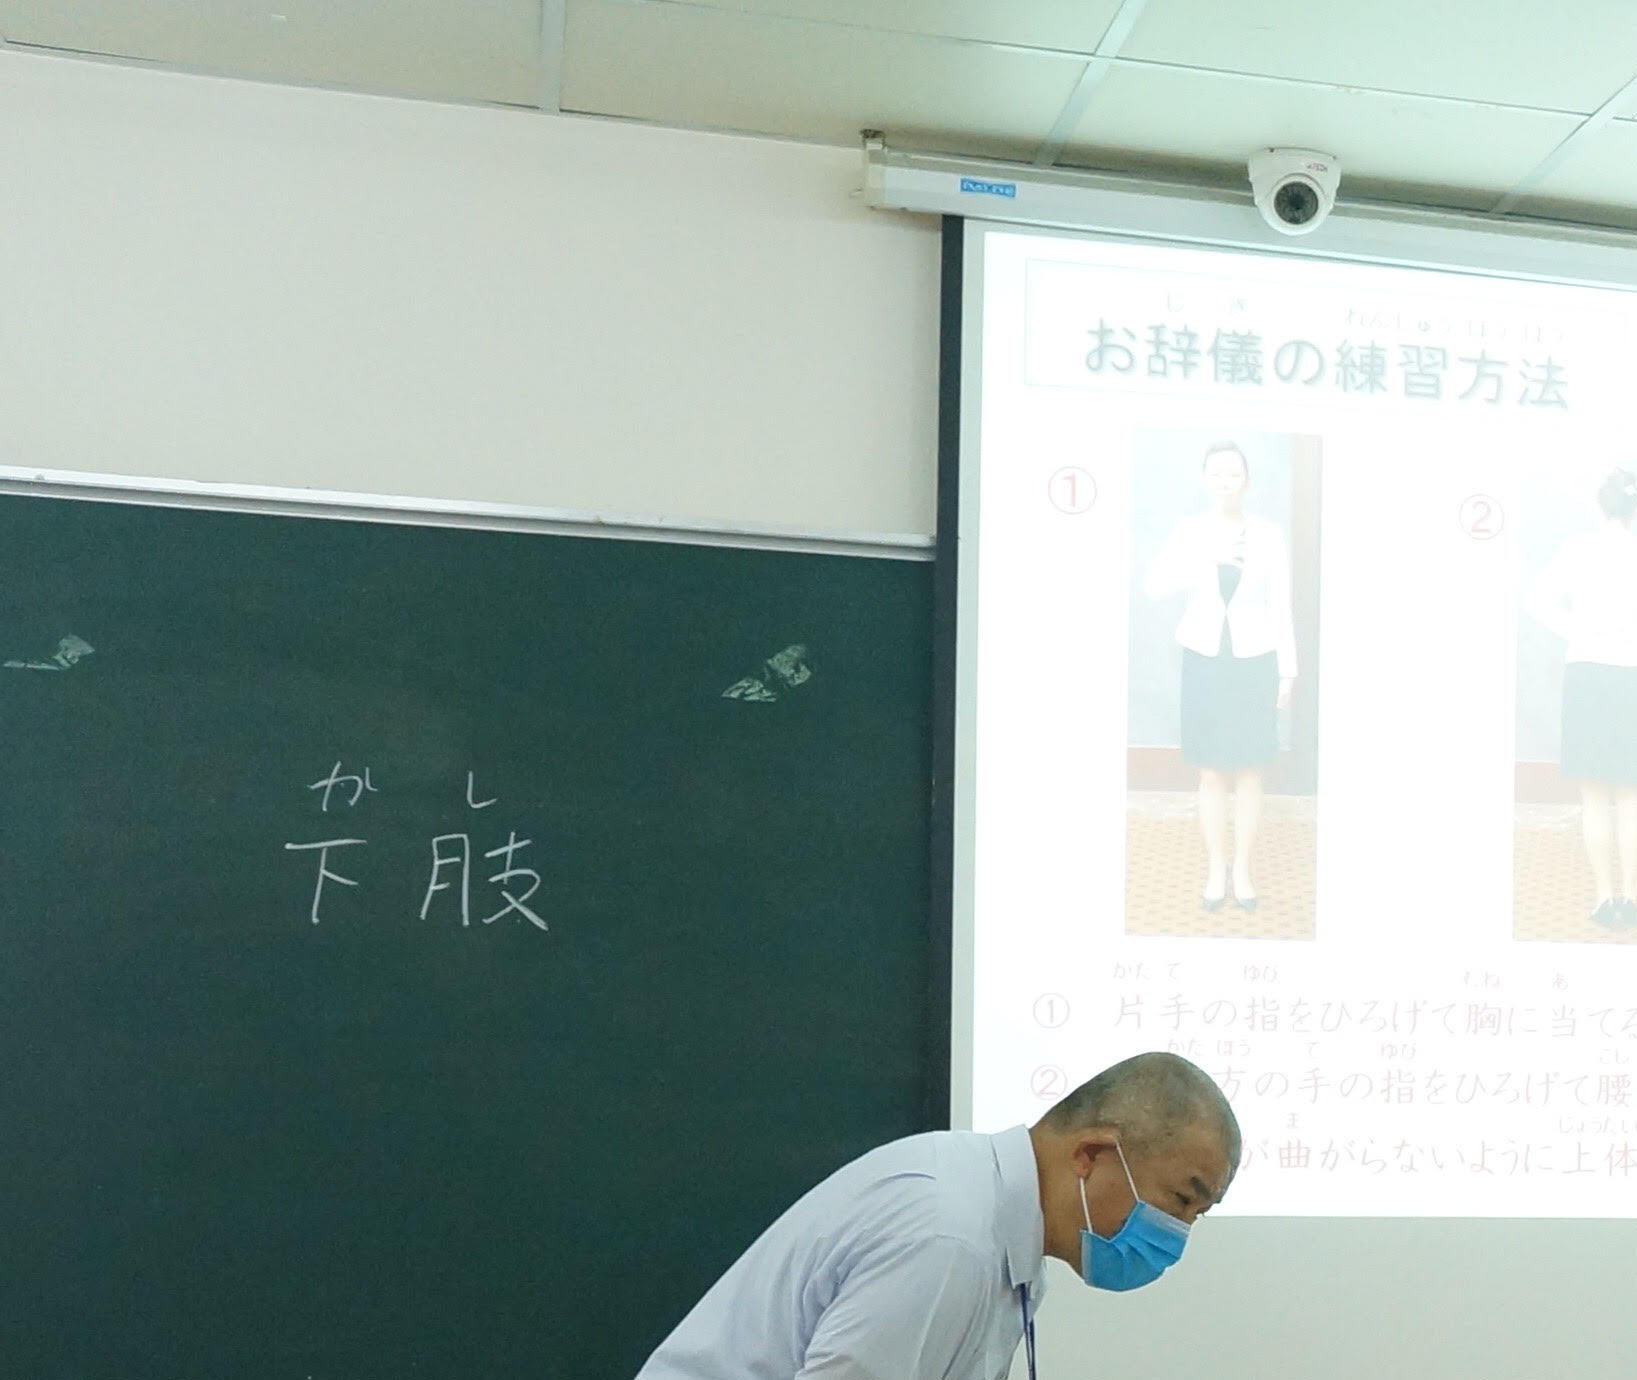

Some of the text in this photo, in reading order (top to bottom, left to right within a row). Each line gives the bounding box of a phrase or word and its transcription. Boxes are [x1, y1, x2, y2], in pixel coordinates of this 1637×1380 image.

[1084, 317, 1570, 411] お辞儀の練習方法
